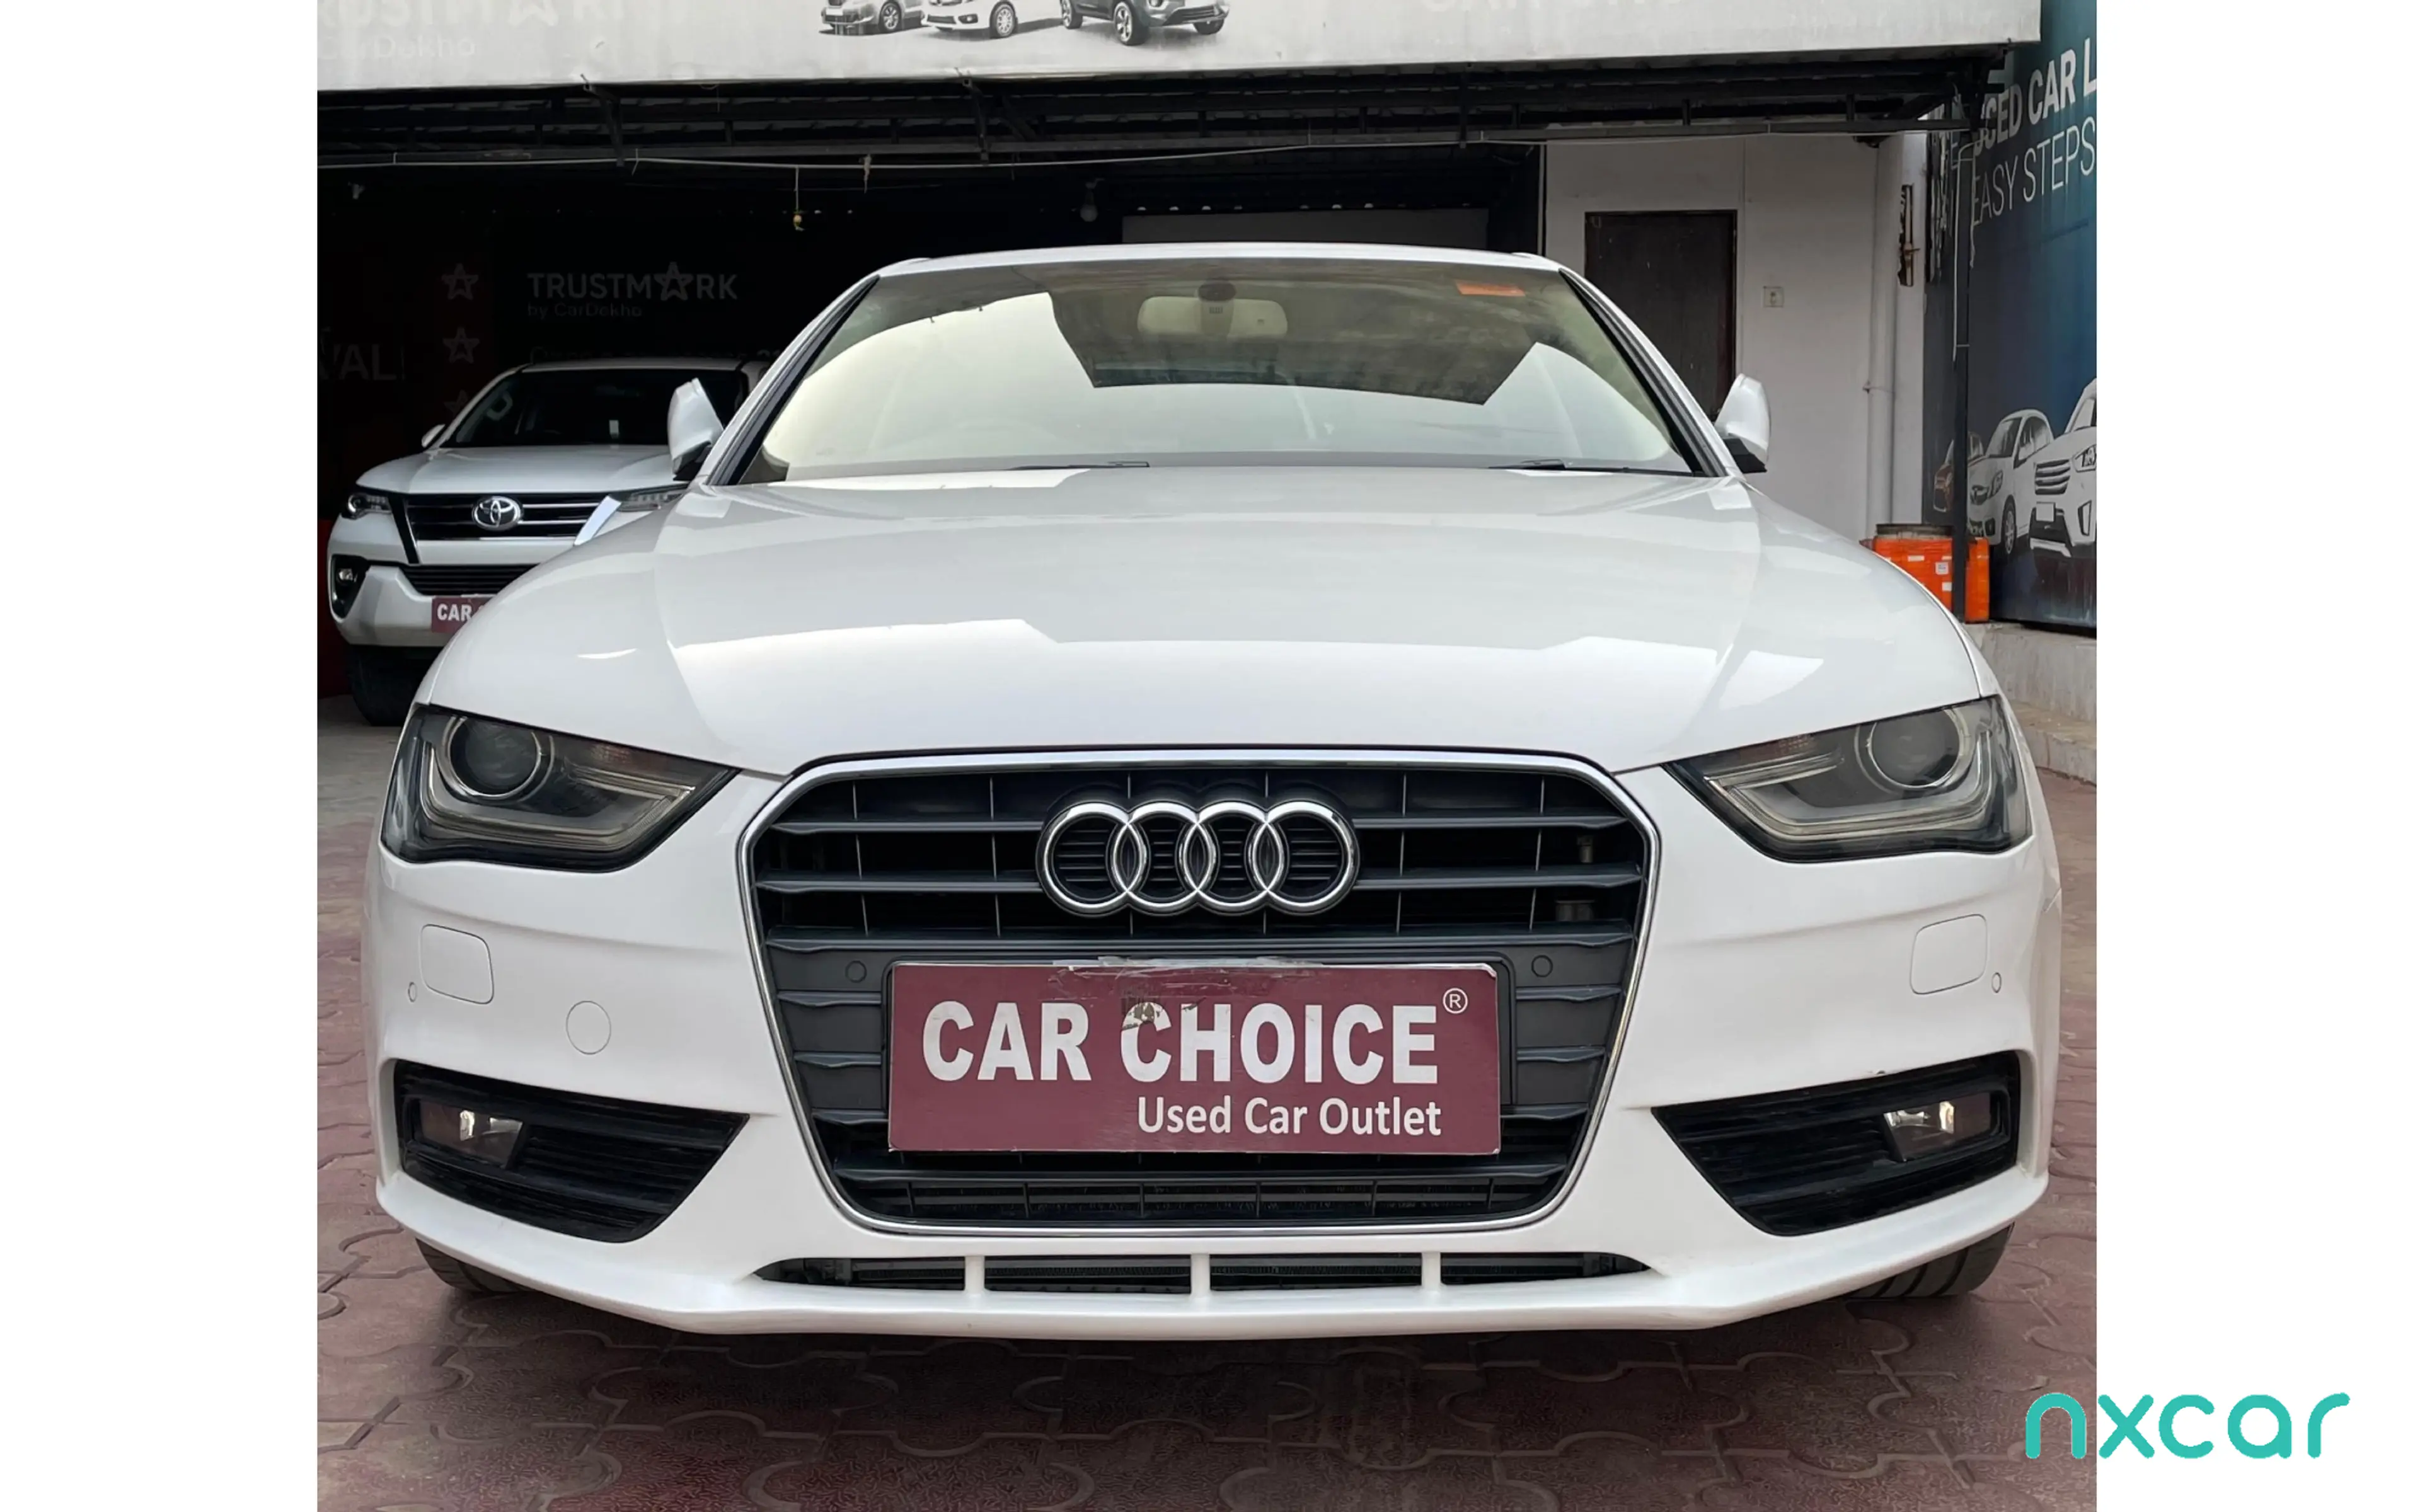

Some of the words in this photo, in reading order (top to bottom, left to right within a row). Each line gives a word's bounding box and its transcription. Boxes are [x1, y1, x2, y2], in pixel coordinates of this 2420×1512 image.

[2028, 49, 2076, 125] CAR
[1972, 156, 2019, 226] EASY
[2023, 117, 2095, 202] STEPS
[527, 302, 547, 319] by
[554, 302, 642, 317] CarDekho
[437, 603, 473, 622] CAR
[923, 1000, 1091, 1082] CAR
[1120, 1002, 1438, 1085] CHOICE
[1138, 1095, 1231, 1134] Used
[1244, 1097, 1308, 1135] Car
[1318, 1097, 1441, 1137] Outlet
